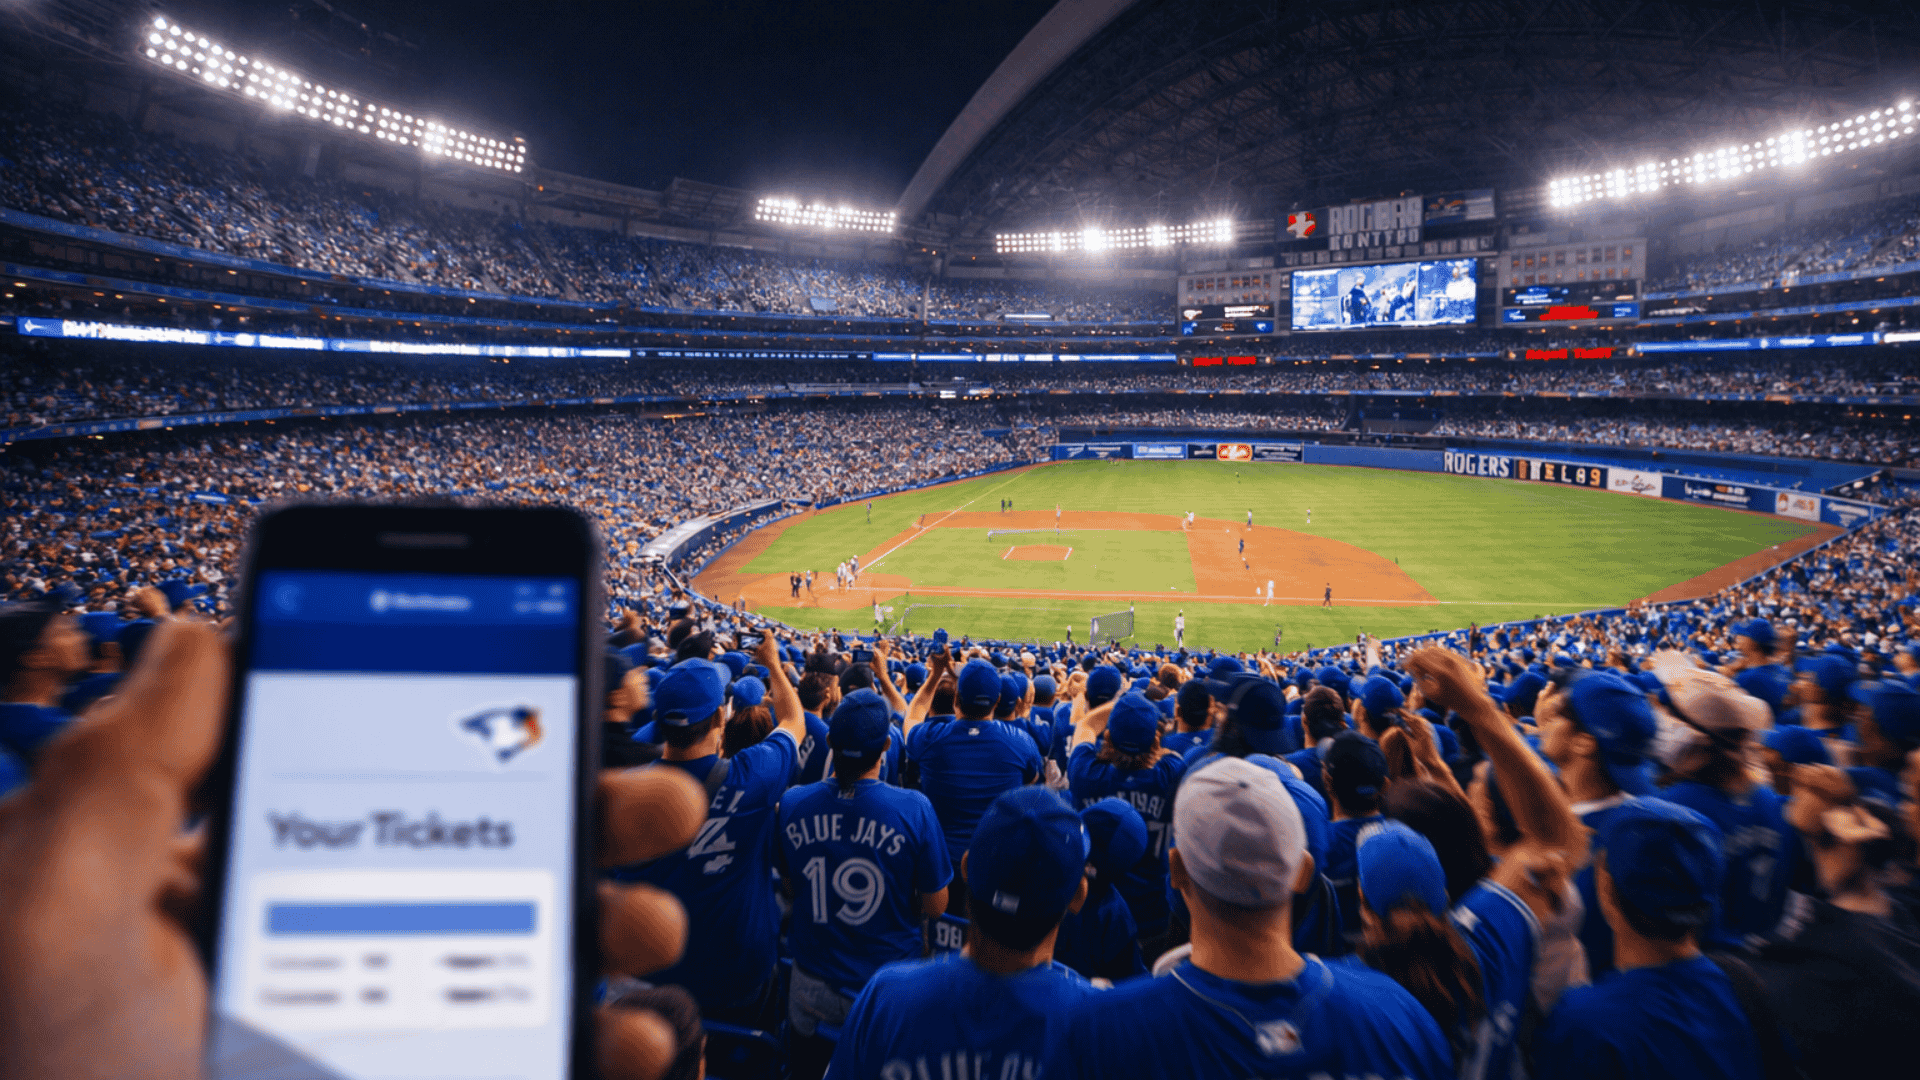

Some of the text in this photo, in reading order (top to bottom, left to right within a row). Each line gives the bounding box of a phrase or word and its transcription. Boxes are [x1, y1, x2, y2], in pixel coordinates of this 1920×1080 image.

[1444, 451, 1510, 478] ROGERS
[264, 808, 516, 850] Your Tickets
[786, 813, 905, 856] BLUE JAYS
[802, 856, 885, 926] 19
